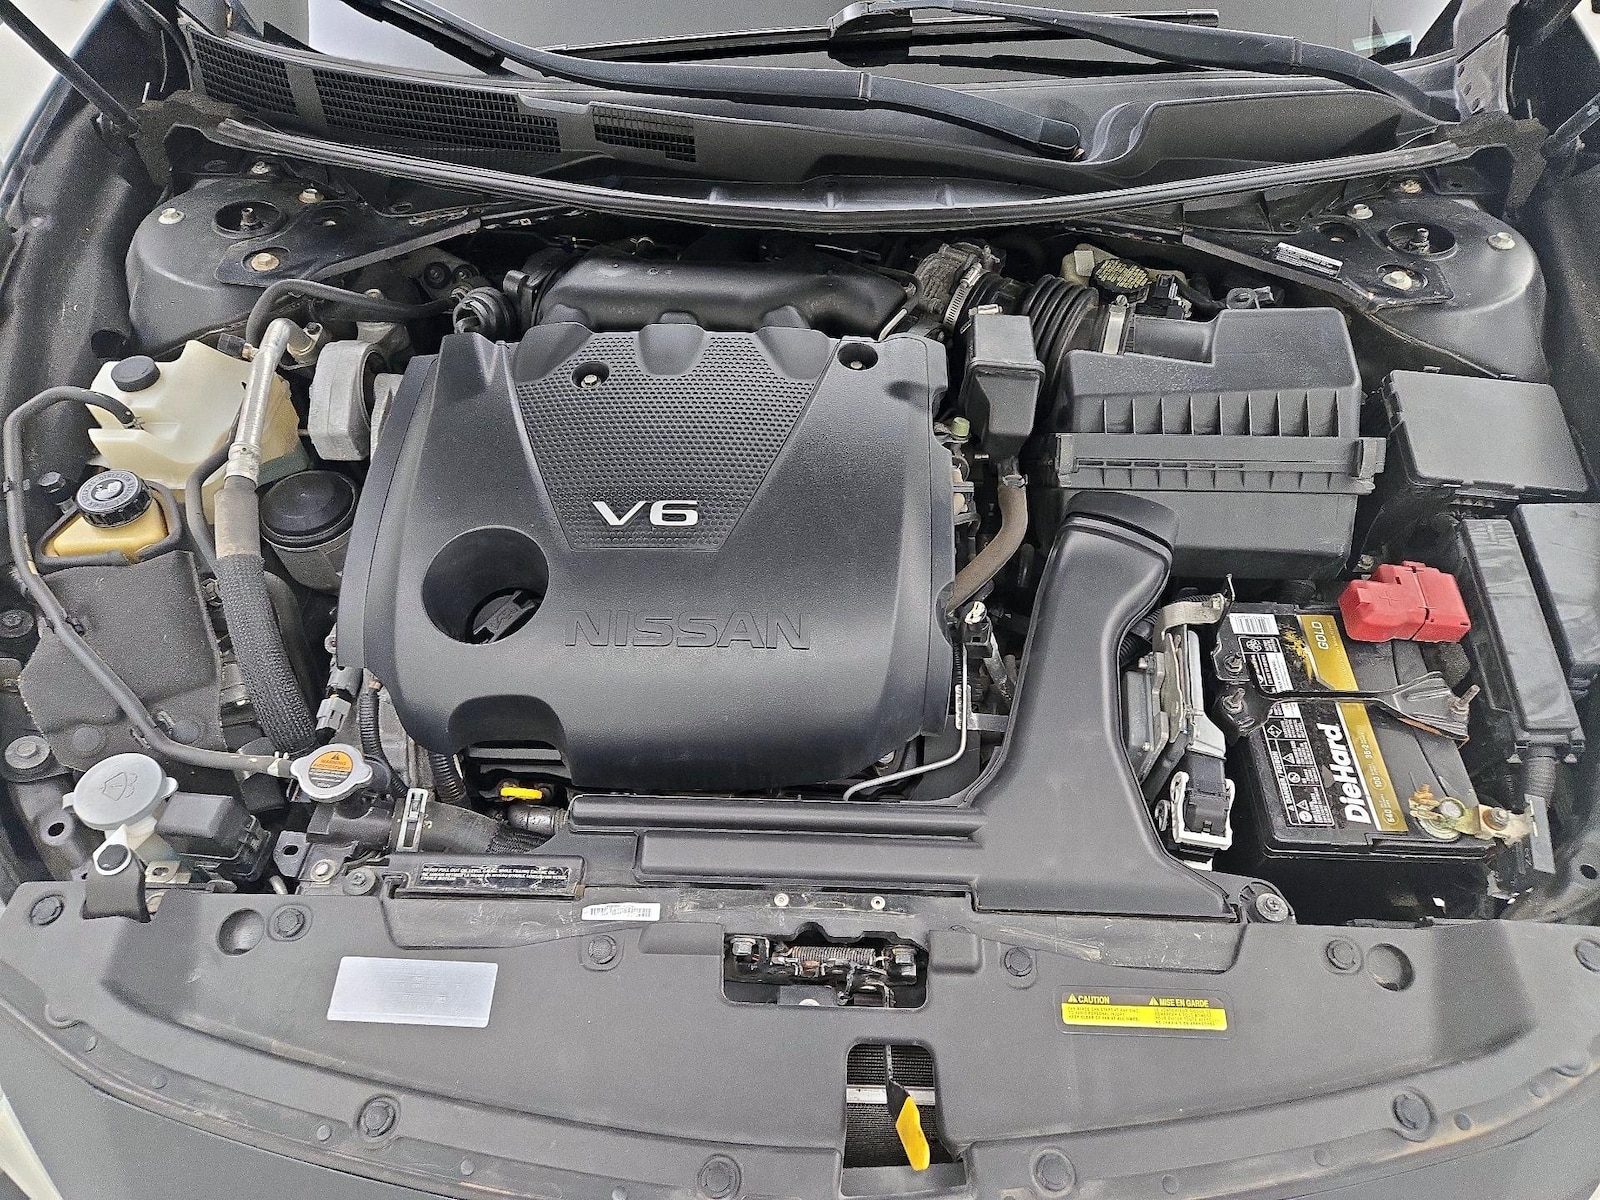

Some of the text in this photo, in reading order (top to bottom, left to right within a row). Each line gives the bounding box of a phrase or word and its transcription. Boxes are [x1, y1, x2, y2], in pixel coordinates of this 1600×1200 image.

[591, 499, 700, 527] V6
[564, 609, 811, 651] NISSAN
[1311, 621, 1329, 650] GOLD
[1316, 723, 1372, 824] DieHard
[1373, 776, 1383, 788] 100
[1078, 995, 1110, 1004] CAUTION
[1159, 998, 1209, 1007] MISE EN GARDE
